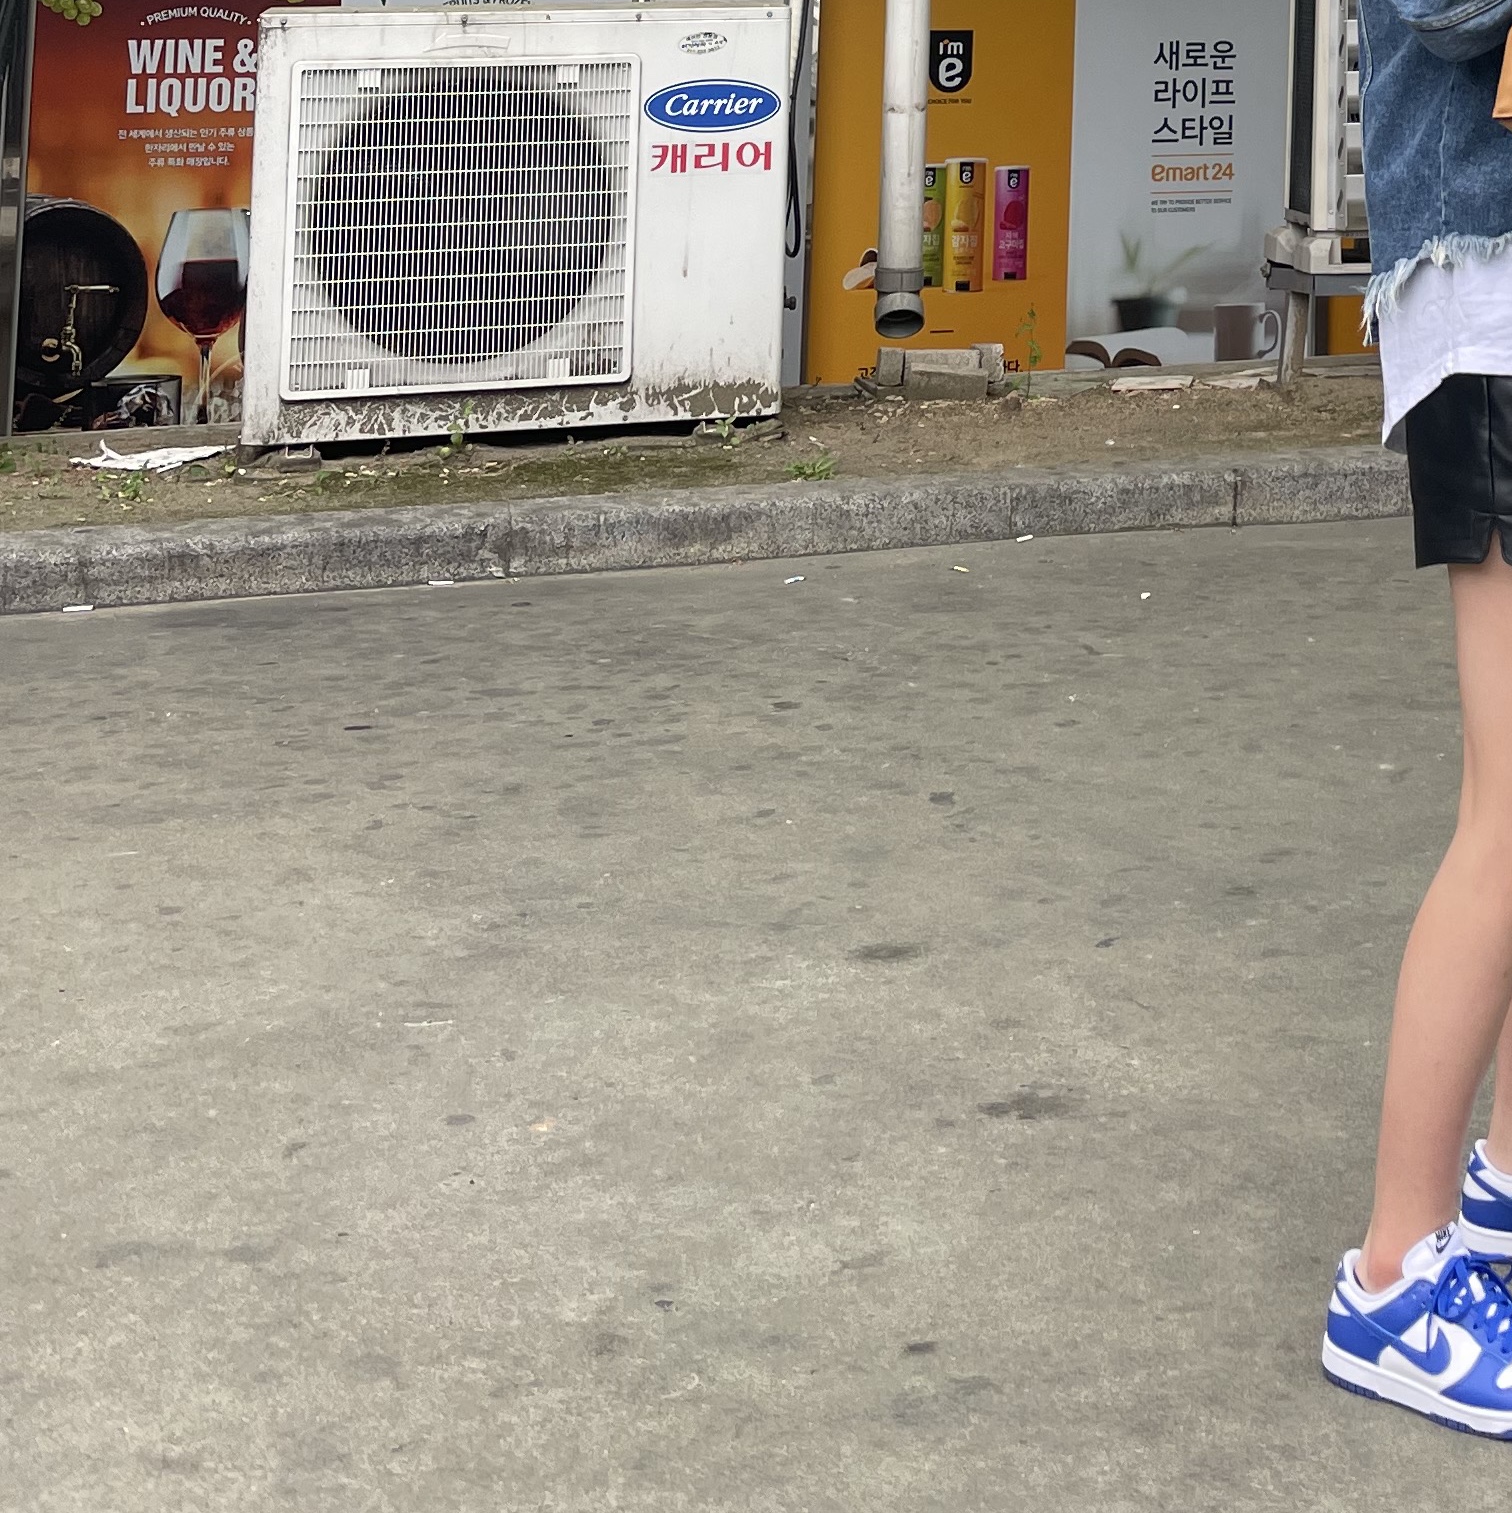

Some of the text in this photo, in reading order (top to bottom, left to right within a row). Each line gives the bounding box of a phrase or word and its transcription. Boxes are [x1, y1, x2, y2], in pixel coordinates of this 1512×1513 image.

[146, 6, 248, 25] PREMIUM QUALITY
[127, 38, 258, 75] WINE &
[1153, 39, 1237, 71] 새로운
[126, 77, 257, 117] LIQUOR
[664, 92, 764, 117] Carrier
[1153, 77, 1236, 109] 라이프
[1151, 114, 1234, 147] 스타일
[207, 142, 217, 152] 수
[650, 140, 772, 174] 캐리어
